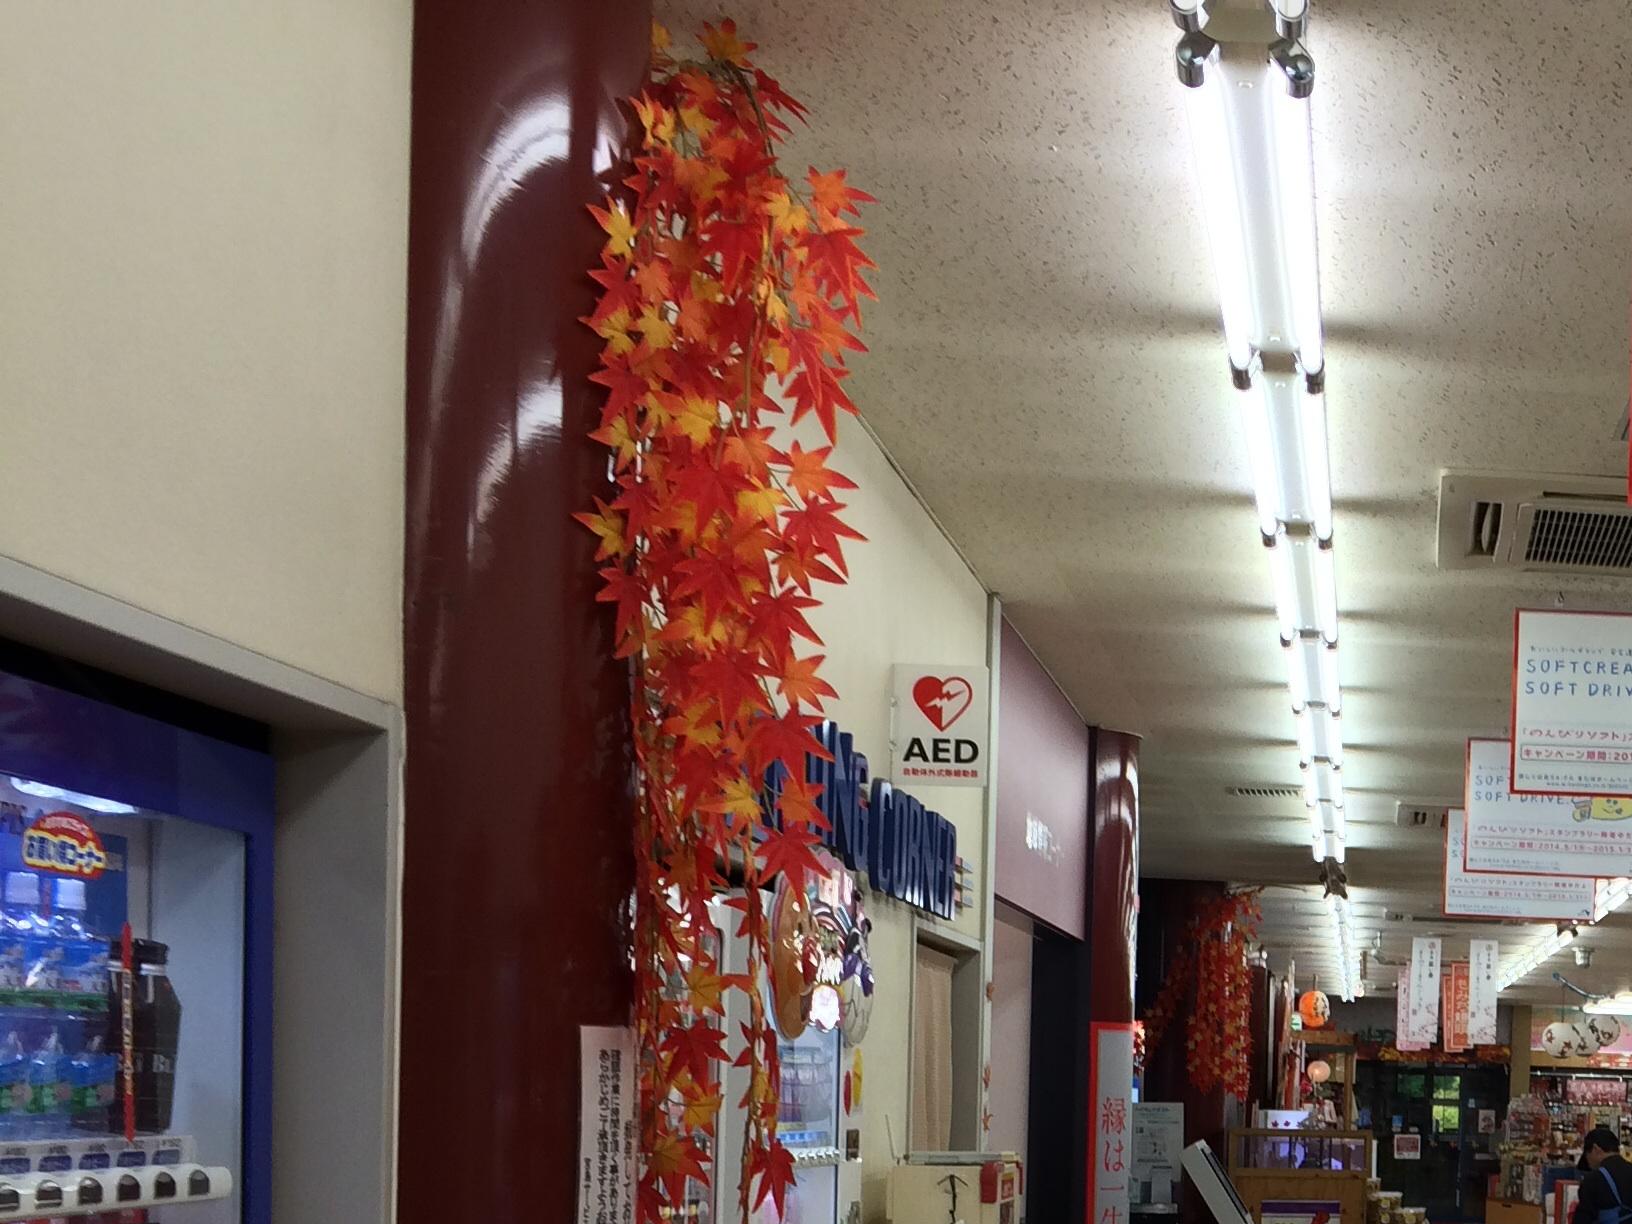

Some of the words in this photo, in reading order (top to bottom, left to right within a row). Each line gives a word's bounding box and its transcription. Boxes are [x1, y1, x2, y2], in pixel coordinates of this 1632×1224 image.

[1525, 681, 1577, 697] SOFT
[903, 737, 979, 765] AED
[870, 776, 957, 921] CORNER
